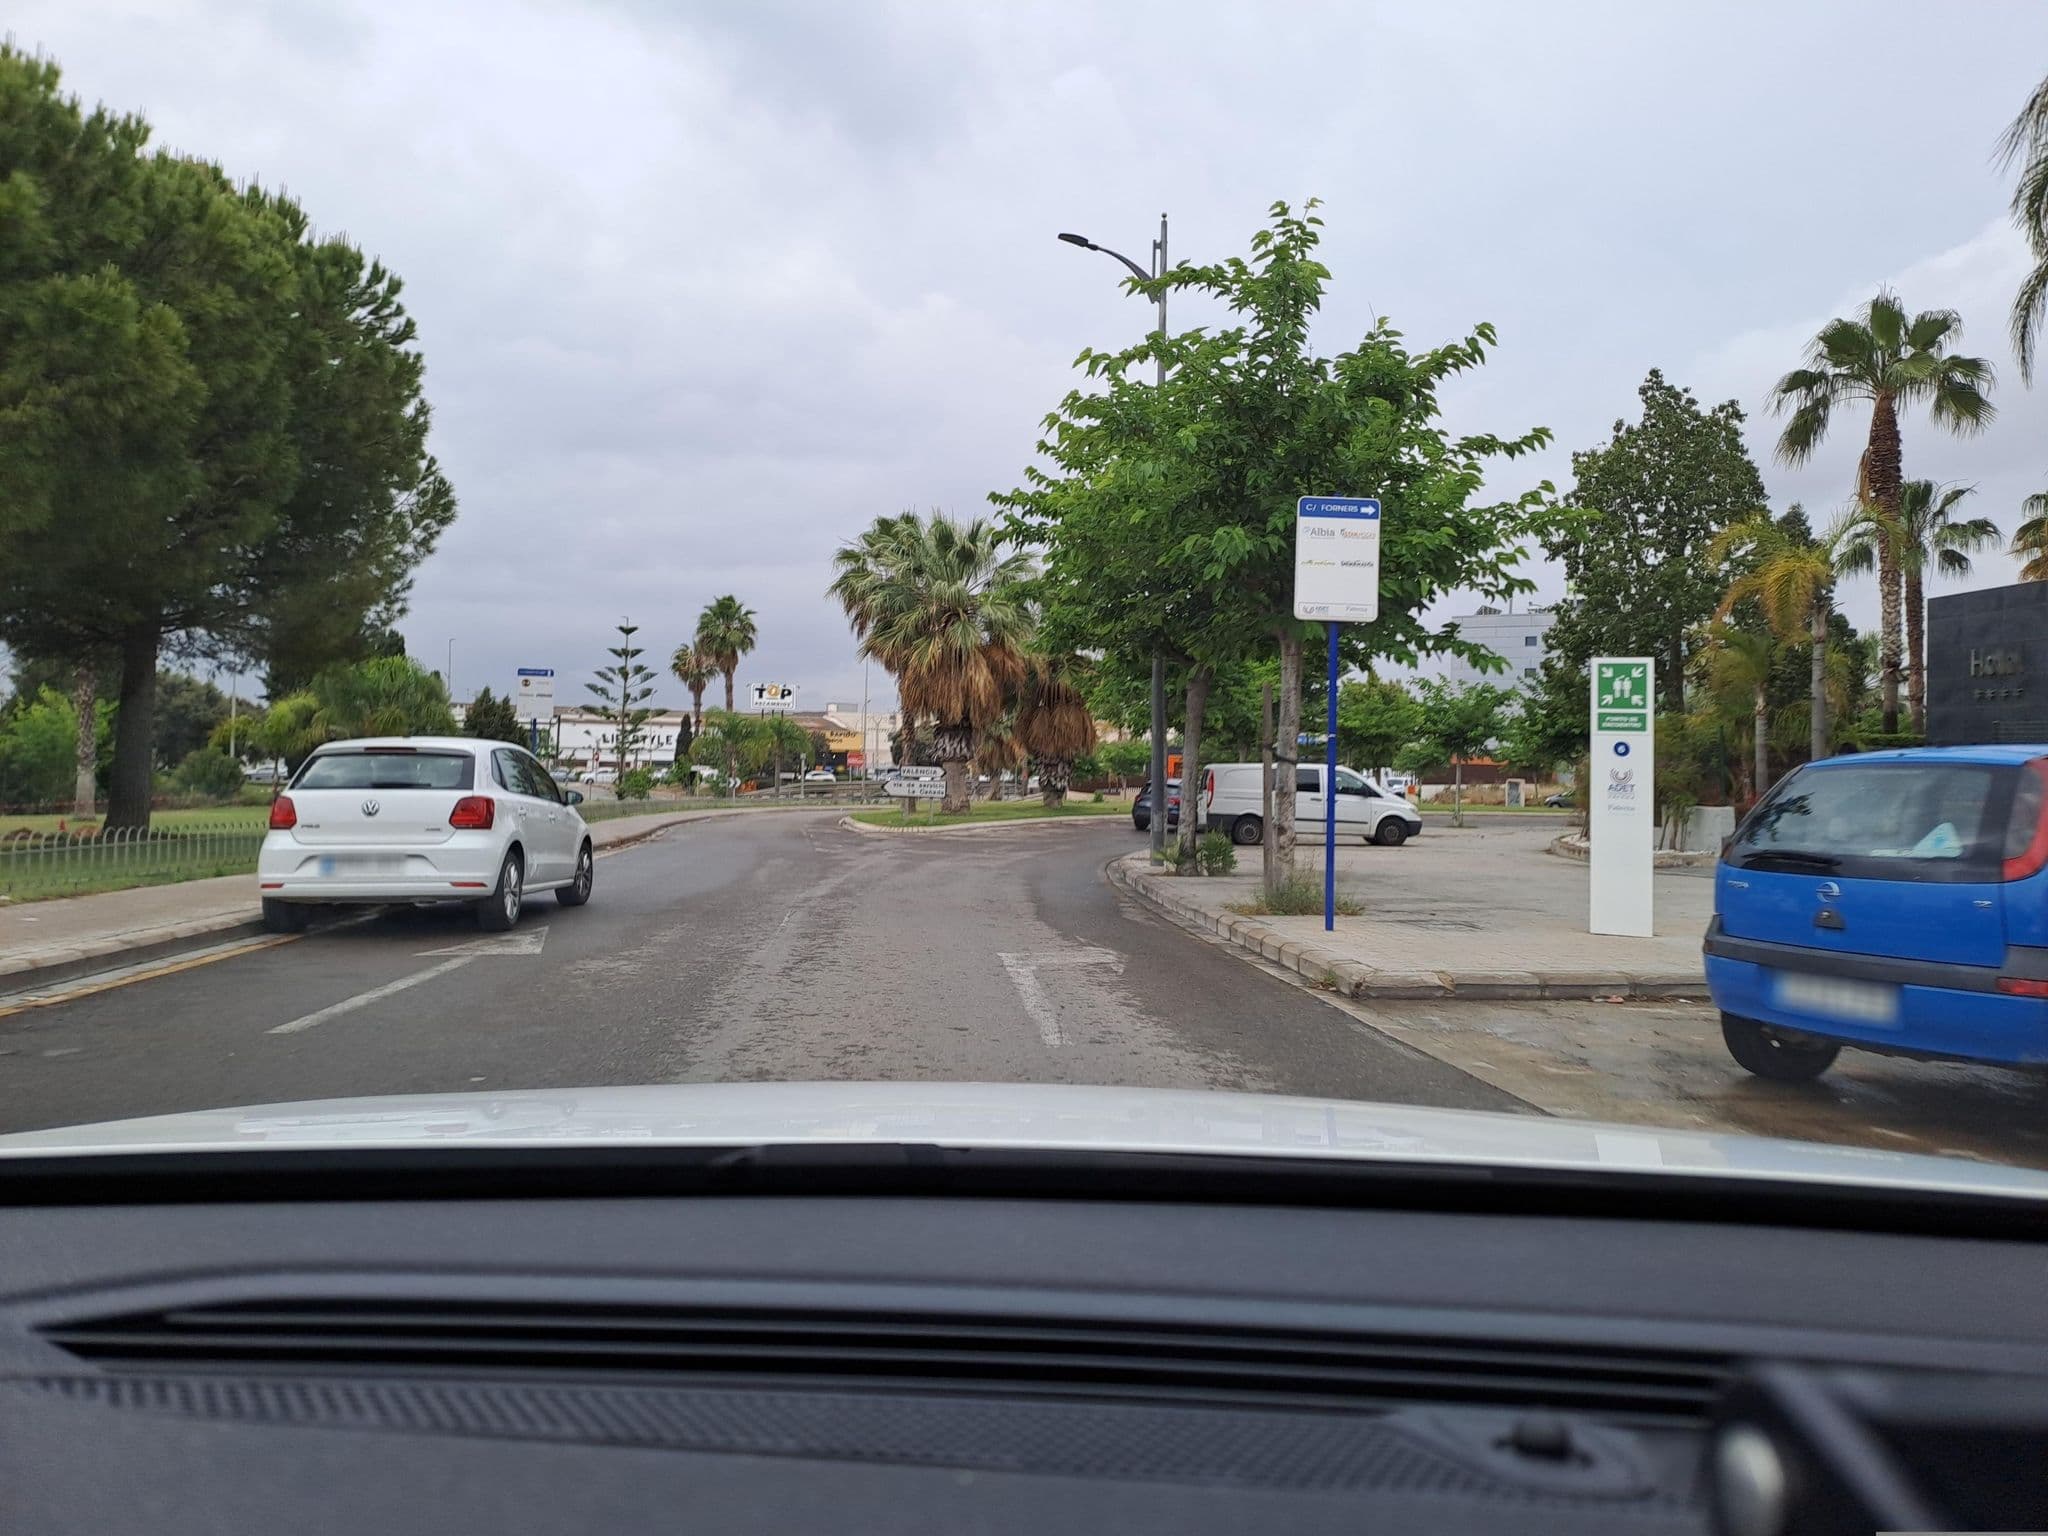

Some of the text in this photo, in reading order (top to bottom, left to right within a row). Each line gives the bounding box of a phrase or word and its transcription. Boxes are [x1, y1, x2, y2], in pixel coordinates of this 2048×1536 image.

[1320, 504, 1359, 513] FORNERS
[1310, 527, 1336, 537] Albia
[602, 733, 673, 745] LIFSTYLE
